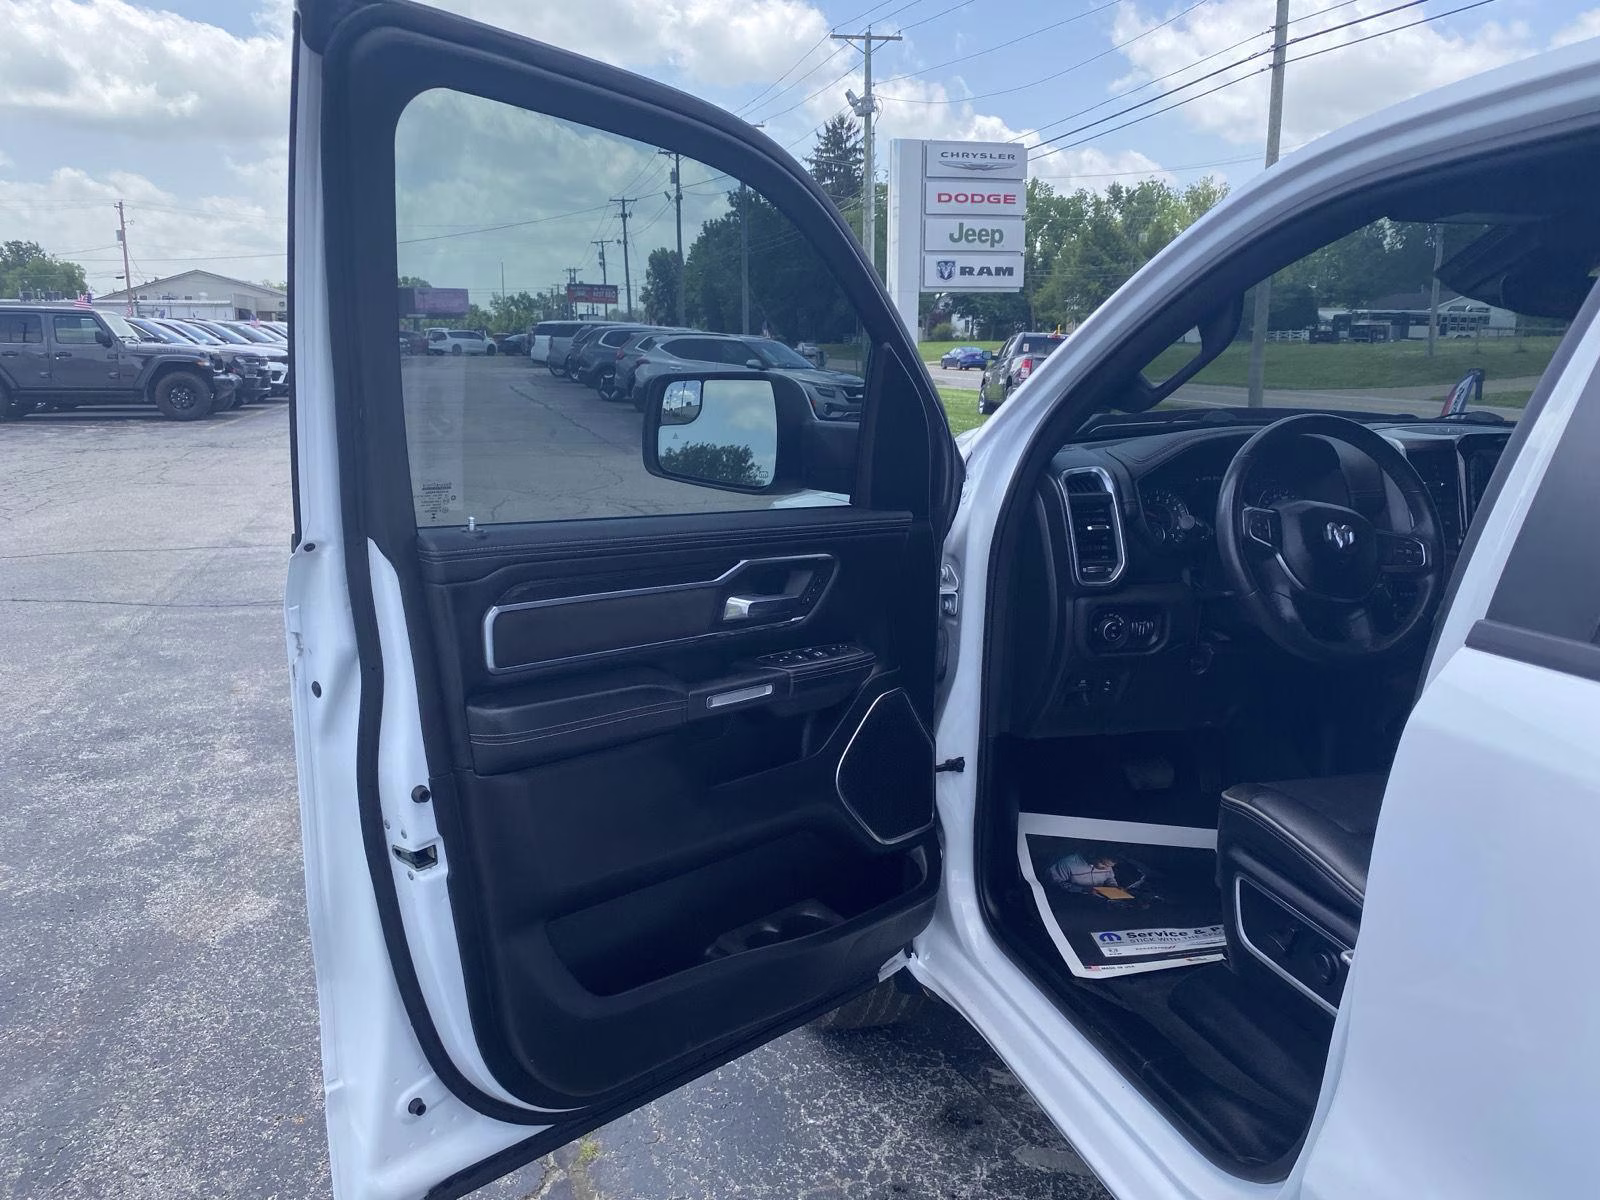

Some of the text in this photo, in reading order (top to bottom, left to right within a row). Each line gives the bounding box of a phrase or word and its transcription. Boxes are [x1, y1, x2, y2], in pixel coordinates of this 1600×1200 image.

[940, 151, 1016, 160] CHRYSLER
[937, 192, 1017, 205] DODGE
[949, 222, 1004, 248] Jeep
[959, 266, 1014, 277] RAM
[1126, 930, 1188, 939] Service
